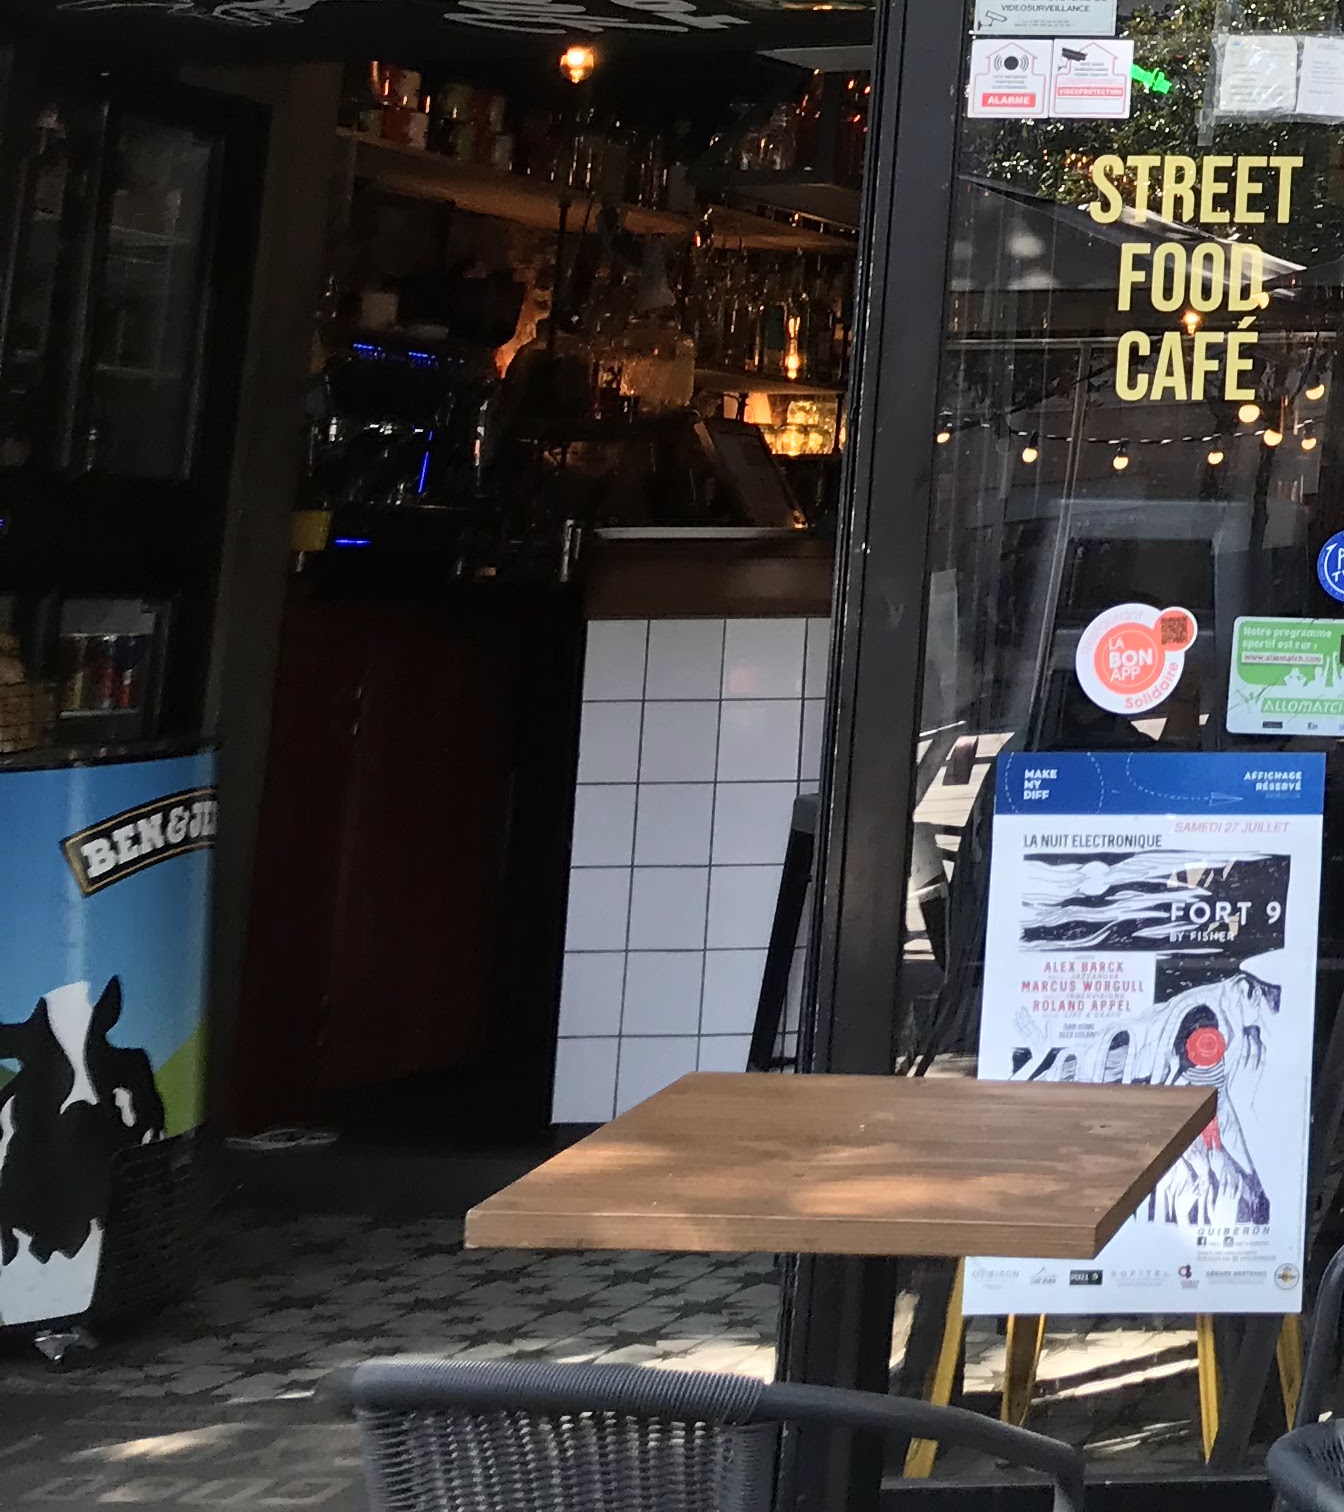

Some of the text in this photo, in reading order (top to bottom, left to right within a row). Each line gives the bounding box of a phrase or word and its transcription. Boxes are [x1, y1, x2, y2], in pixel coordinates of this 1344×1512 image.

[987, 95, 1030, 105] ALARME
[1089, 155, 1304, 224] STREET
[1117, 242, 1264, 312] FOOD
[1115, 316, 1260, 401] CAFÉ
[1243, 626, 1332, 640] Notre programme
[1108, 637, 1125, 651] LA
[1242, 638, 1275, 650] sportif
[1277, 640, 1293, 649] est
[1109, 649, 1154, 668] BON
[1109, 667, 1141, 682] APP
[1125, 662, 1179, 709] Solidaire
[1024, 769, 1057, 779] MAKE
[1244, 771, 1302, 781] AFFICHAGE
[1024, 780, 1041, 789] MY
[1256, 780, 1302, 791] RÉSERVÉ
[1023, 790, 1049, 800] DIFF
[1175, 822, 1290, 833] SAMEDI 27 JUILLET
[1024, 834, 1162, 849] LA NUIT ELECTRONIQUE
[1171, 901, 1281, 926] FORT 9
[1169, 931, 1234, 943] BY FISHER
[1044, 961, 1124, 973] ALEX BARCK
[1020, 980, 1144, 992] MARCUS WORGULL
[1032, 999, 1132, 1012] ROLAND APPEL
[1197, 1227, 1271, 1236] QUIBERON
